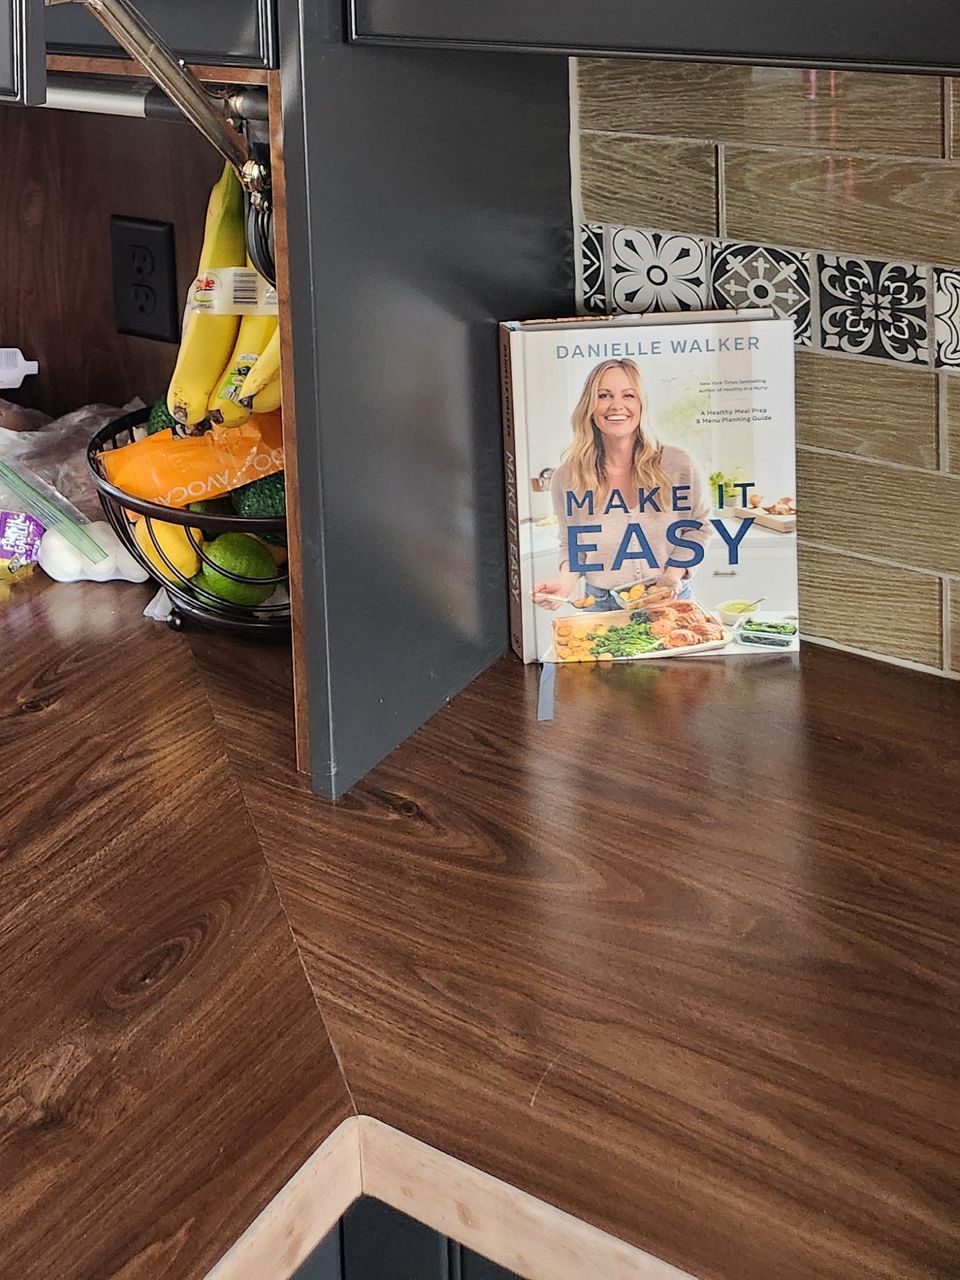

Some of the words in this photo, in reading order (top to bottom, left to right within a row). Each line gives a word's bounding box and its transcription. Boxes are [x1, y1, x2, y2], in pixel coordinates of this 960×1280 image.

[556, 340, 662, 359] DANIELLE
[670, 336, 760, 354] WALKER
[707, 408, 733, 416] Healthy
[506, 451, 516, 513] MAKE
[566, 485, 692, 517] MAKE
[717, 482, 755, 510] IT
[508, 517, 518, 539] IT
[567, 517, 756, 573] EASY
[510, 543, 520, 603] EASY
